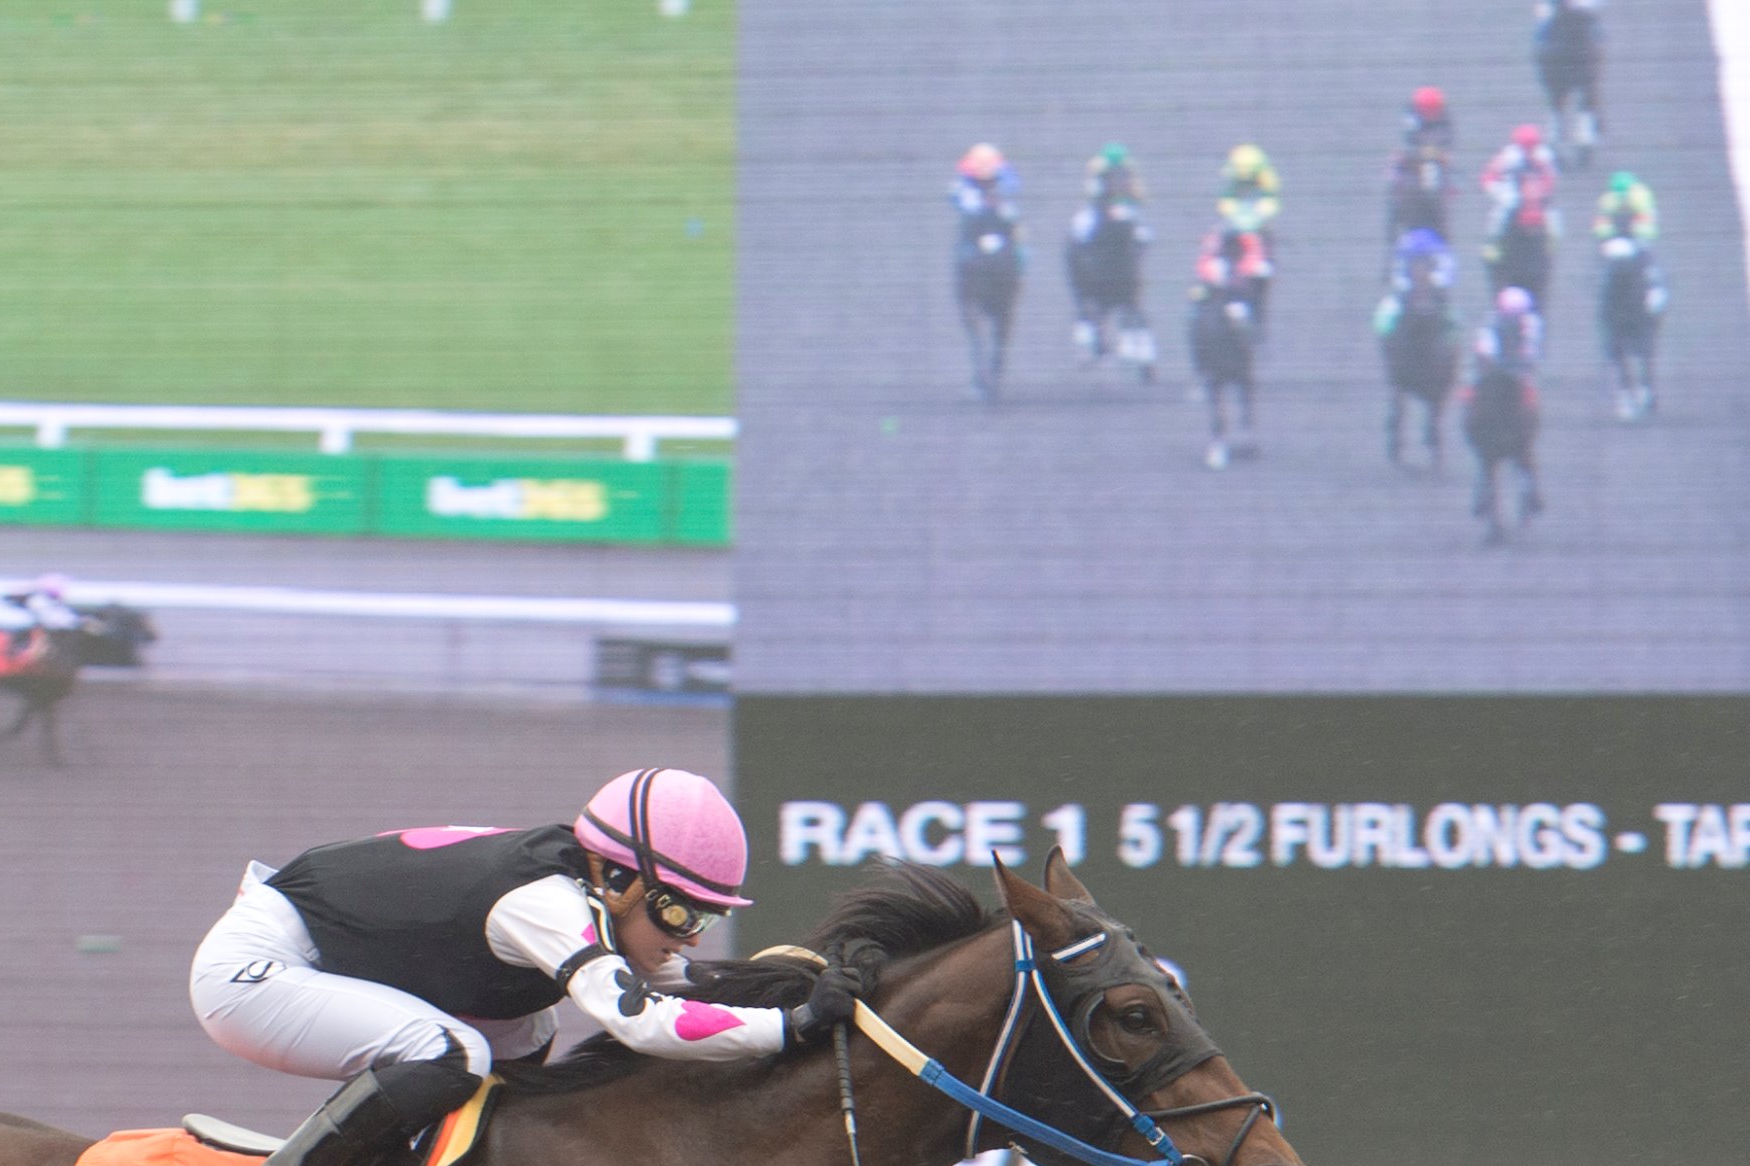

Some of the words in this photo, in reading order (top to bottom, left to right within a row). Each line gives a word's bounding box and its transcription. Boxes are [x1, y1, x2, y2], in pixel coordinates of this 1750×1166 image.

[778, 801, 1026, 867] RACE
[1041, 802, 1086, 867] 1
[1117, 803, 1163, 868] 5
[1167, 802, 1263, 868] 1/2
[1269, 802, 1608, 869] FURLONGS
